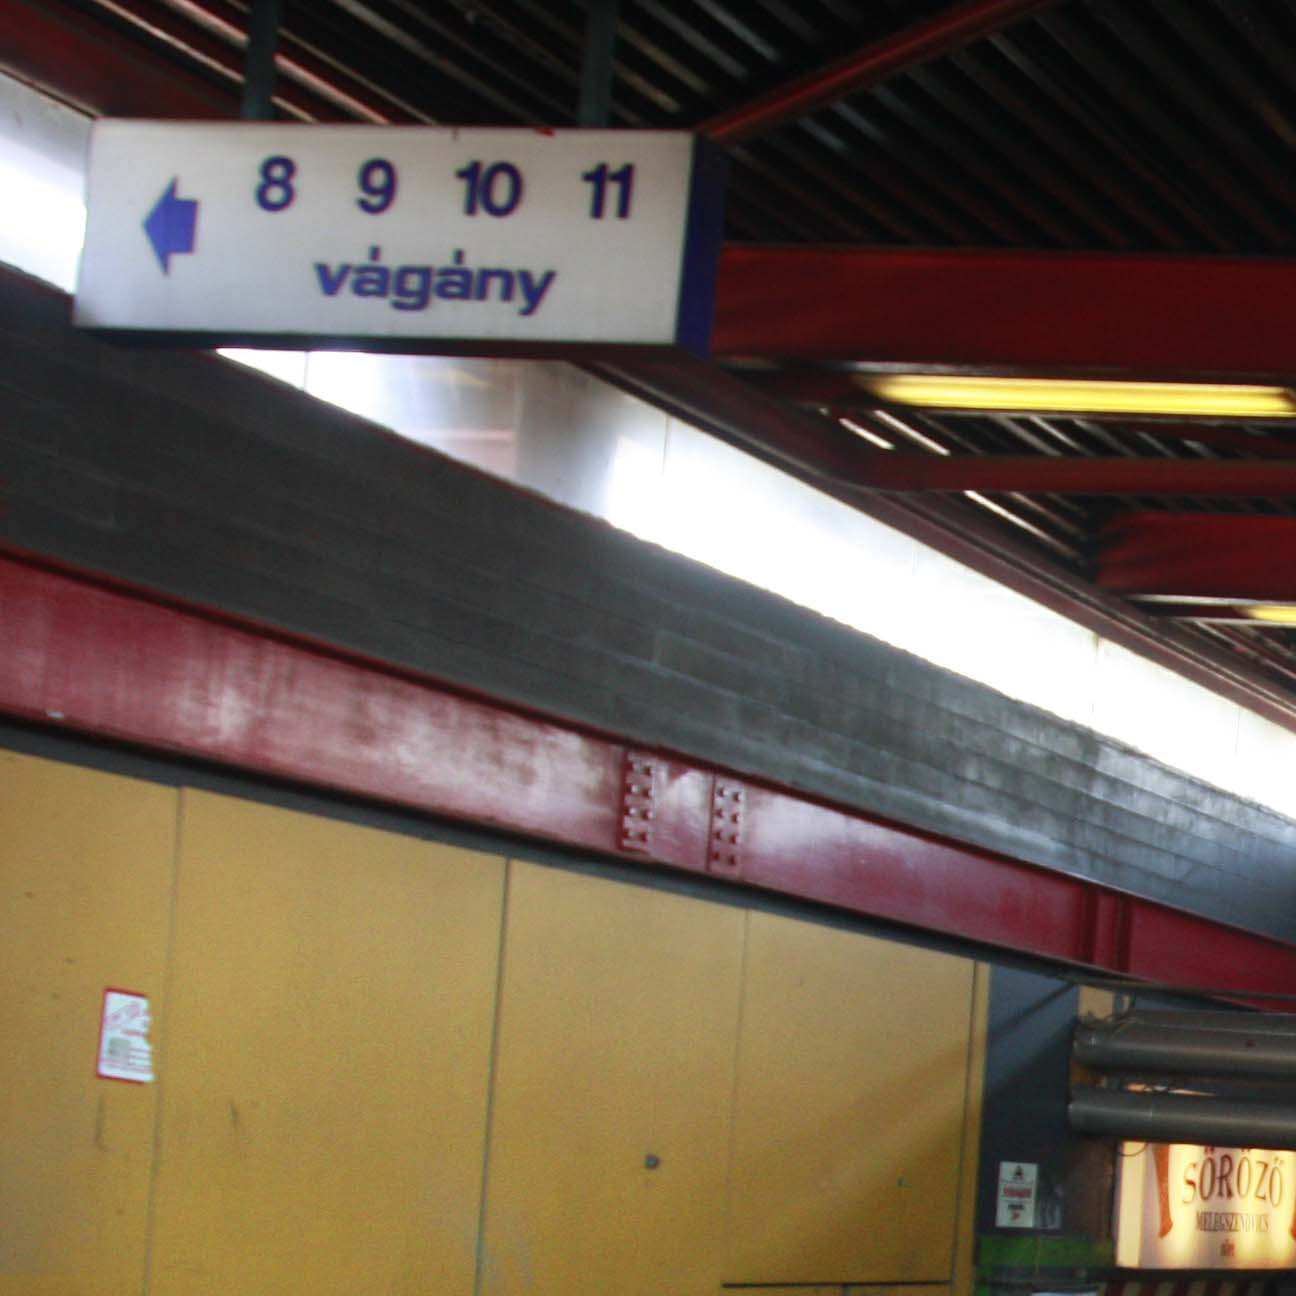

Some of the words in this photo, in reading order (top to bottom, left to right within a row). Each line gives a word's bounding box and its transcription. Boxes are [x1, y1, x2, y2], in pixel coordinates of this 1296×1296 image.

[255, 155, 297, 213] 8
[356, 157, 398, 216] 9
[454, 159, 524, 219] 10
[580, 160, 638, 221] 11
[313, 246, 557, 318] vágány
